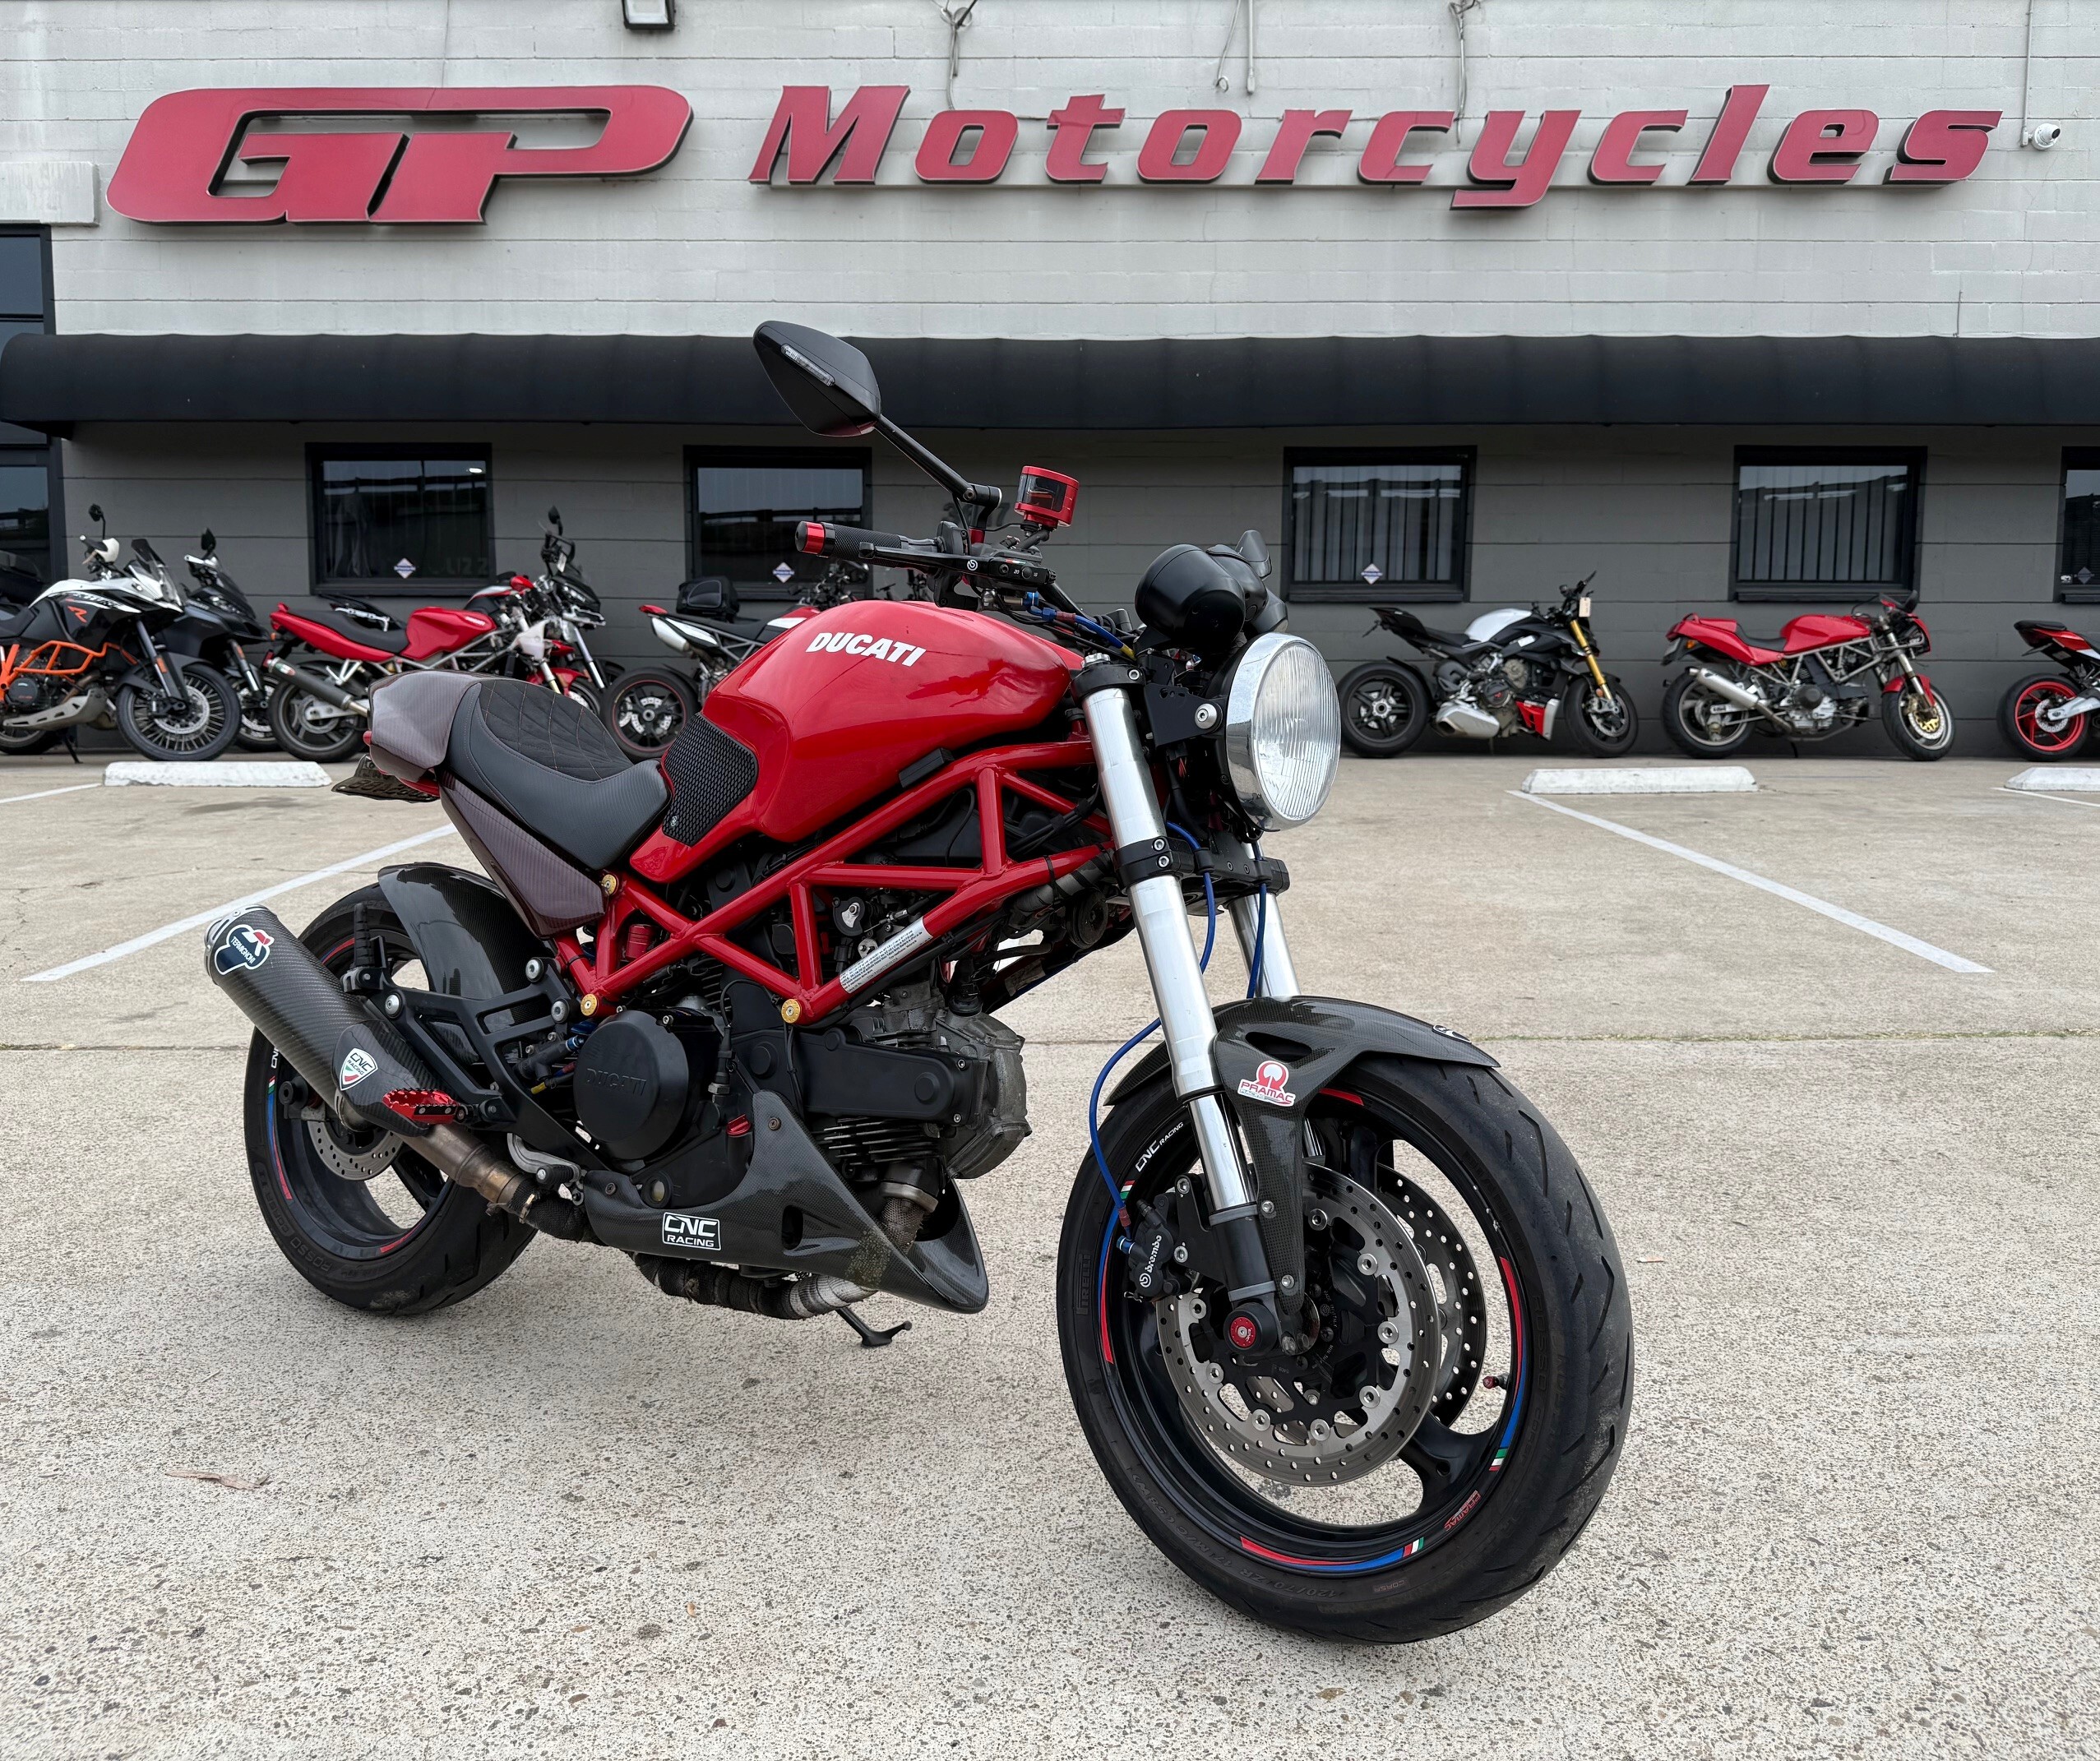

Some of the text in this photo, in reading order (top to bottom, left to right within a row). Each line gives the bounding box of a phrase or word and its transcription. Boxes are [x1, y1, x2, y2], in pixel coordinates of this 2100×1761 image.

[105, 84, 2003, 225] GP Motorcycles
[805, 632, 927, 667] DUCATI
[230, 936, 257, 964] TERMIGNONI
[271, 1047, 280, 1069] CN
[347, 1059, 365, 1075] RACING
[349, 1052, 373, 1072] CNC
[586, 1068, 648, 1097] DUCATI
[1241, 1081, 1294, 1103] PRAMAC
[1136, 1121, 1184, 1172] CNC RACING
[664, 1215, 718, 1237] CNC
[290, 1236, 332, 1272] ROSSO
[667, 1234, 715, 1247] RACING
[1145, 1235, 1162, 1273] brembo
[1075, 1254, 1091, 1315] PIRELLI
[1444, 1492, 1481, 1532] PRAMAC
[1175, 1526, 1210, 1552] M/C
[1237, 1567, 1267, 1583] ZR
[1274, 1581, 1337, 1597] 120/70
